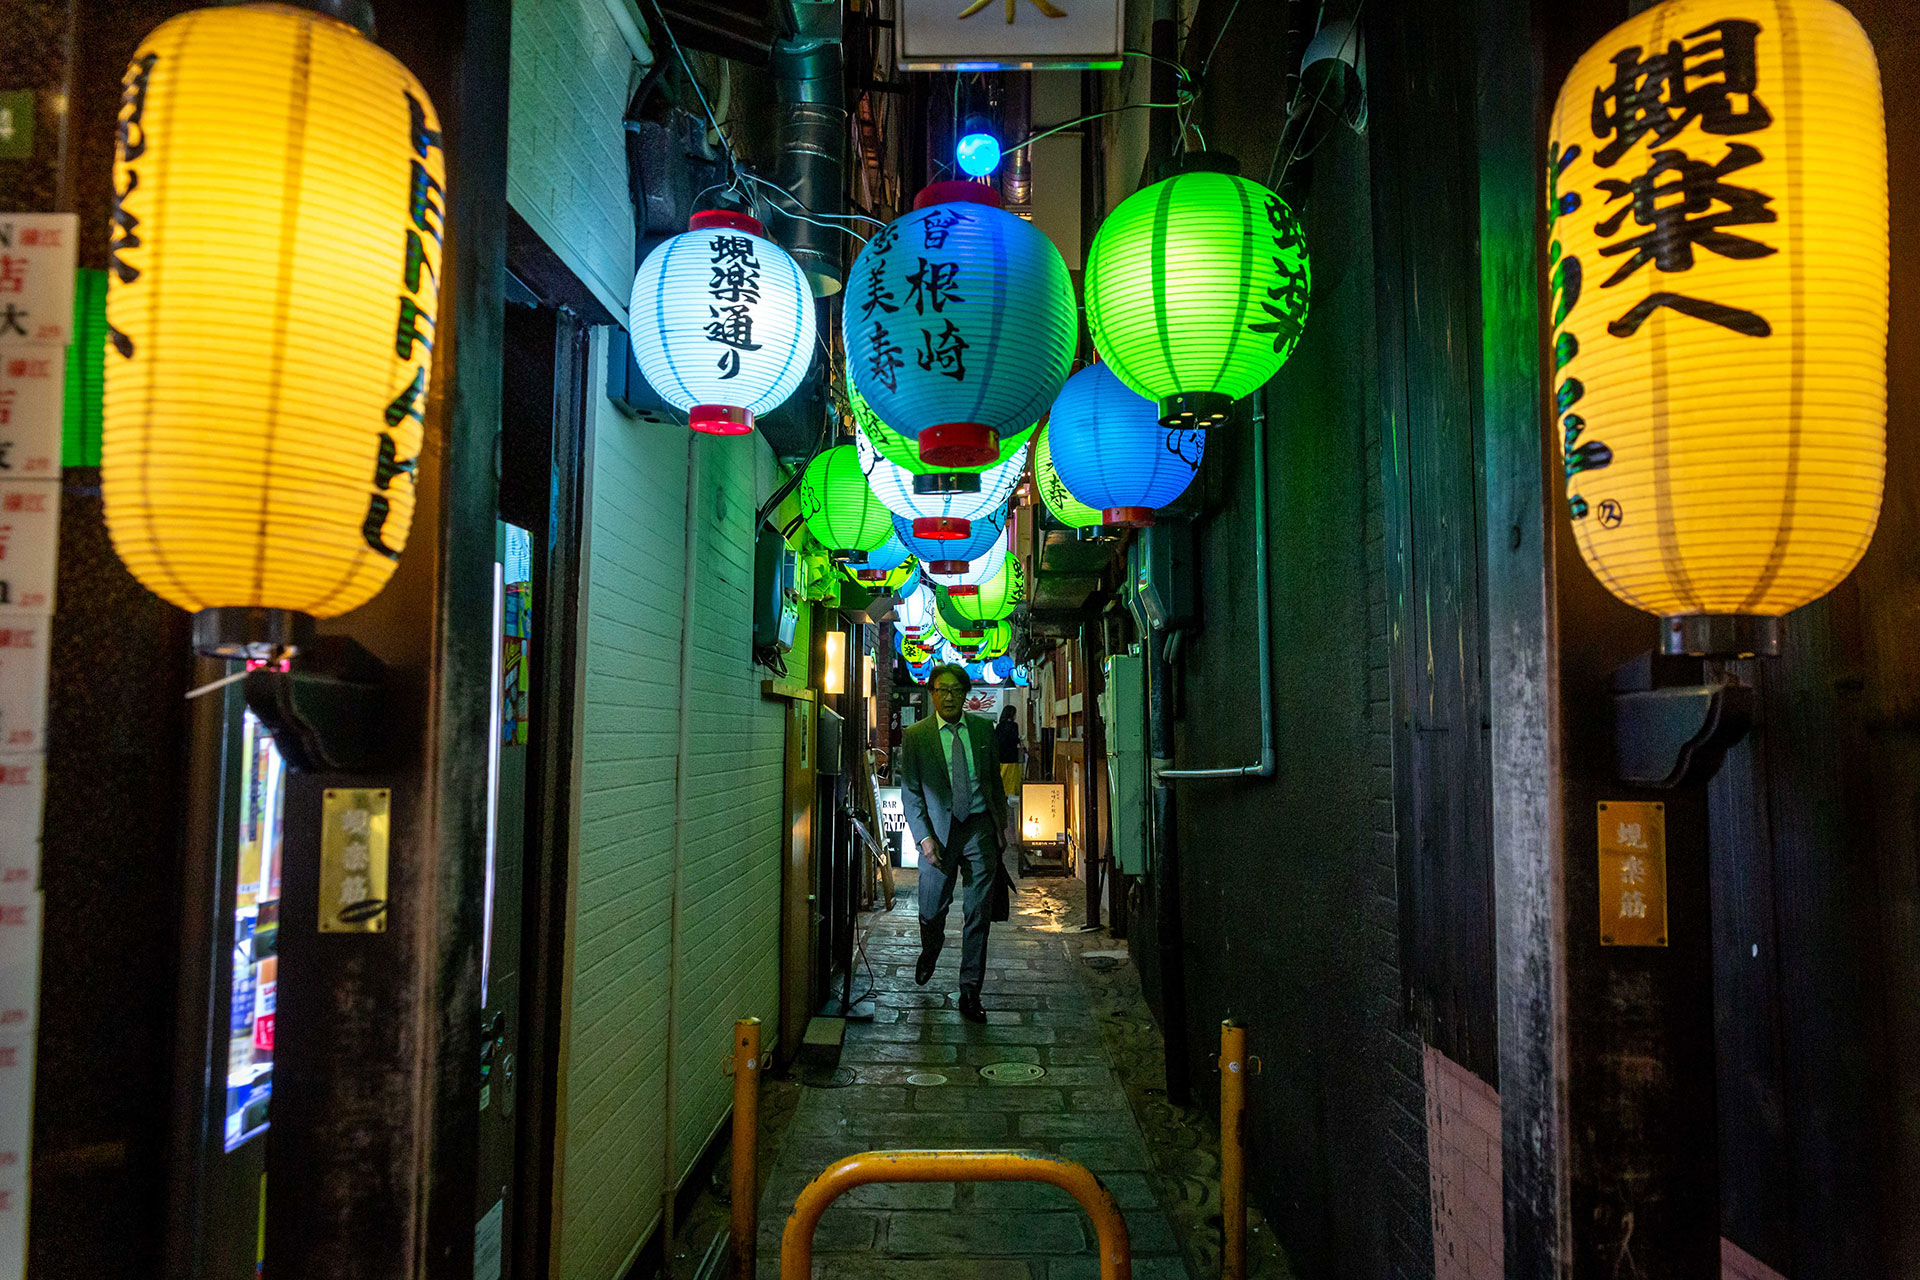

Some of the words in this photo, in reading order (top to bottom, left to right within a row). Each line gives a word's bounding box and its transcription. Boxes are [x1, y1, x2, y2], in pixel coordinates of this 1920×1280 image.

[703, 235, 763, 380] 蜆楽通り
[882, 800, 897, 809] BAR
